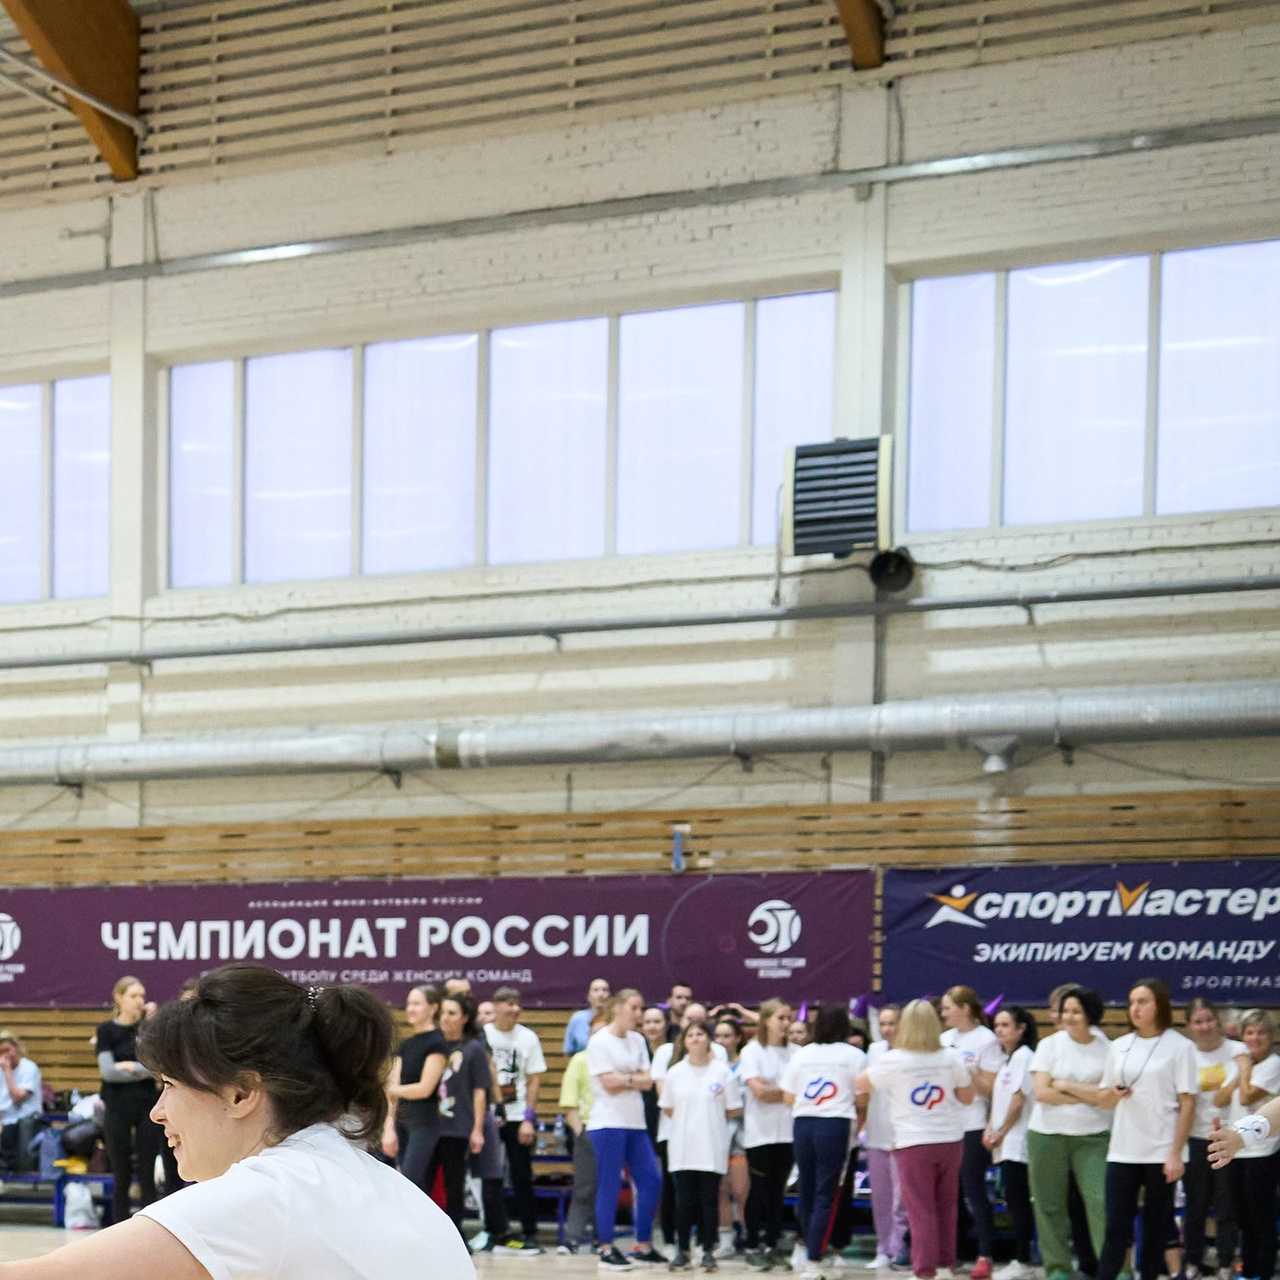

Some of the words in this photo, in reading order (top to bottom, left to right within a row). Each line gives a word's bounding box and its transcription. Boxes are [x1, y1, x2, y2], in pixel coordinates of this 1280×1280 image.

[100, 917, 407, 961] ЧЕМПИОНАТ
[418, 914, 650, 959] РОССИИ
[973, 942, 1135, 963] ЭКИПИРУЕМ
[1138, 940, 1276, 963] КОМАНДУ
[340, 968, 390, 983] СРЕДИ
[466, 968, 533, 984] КОМАНД
